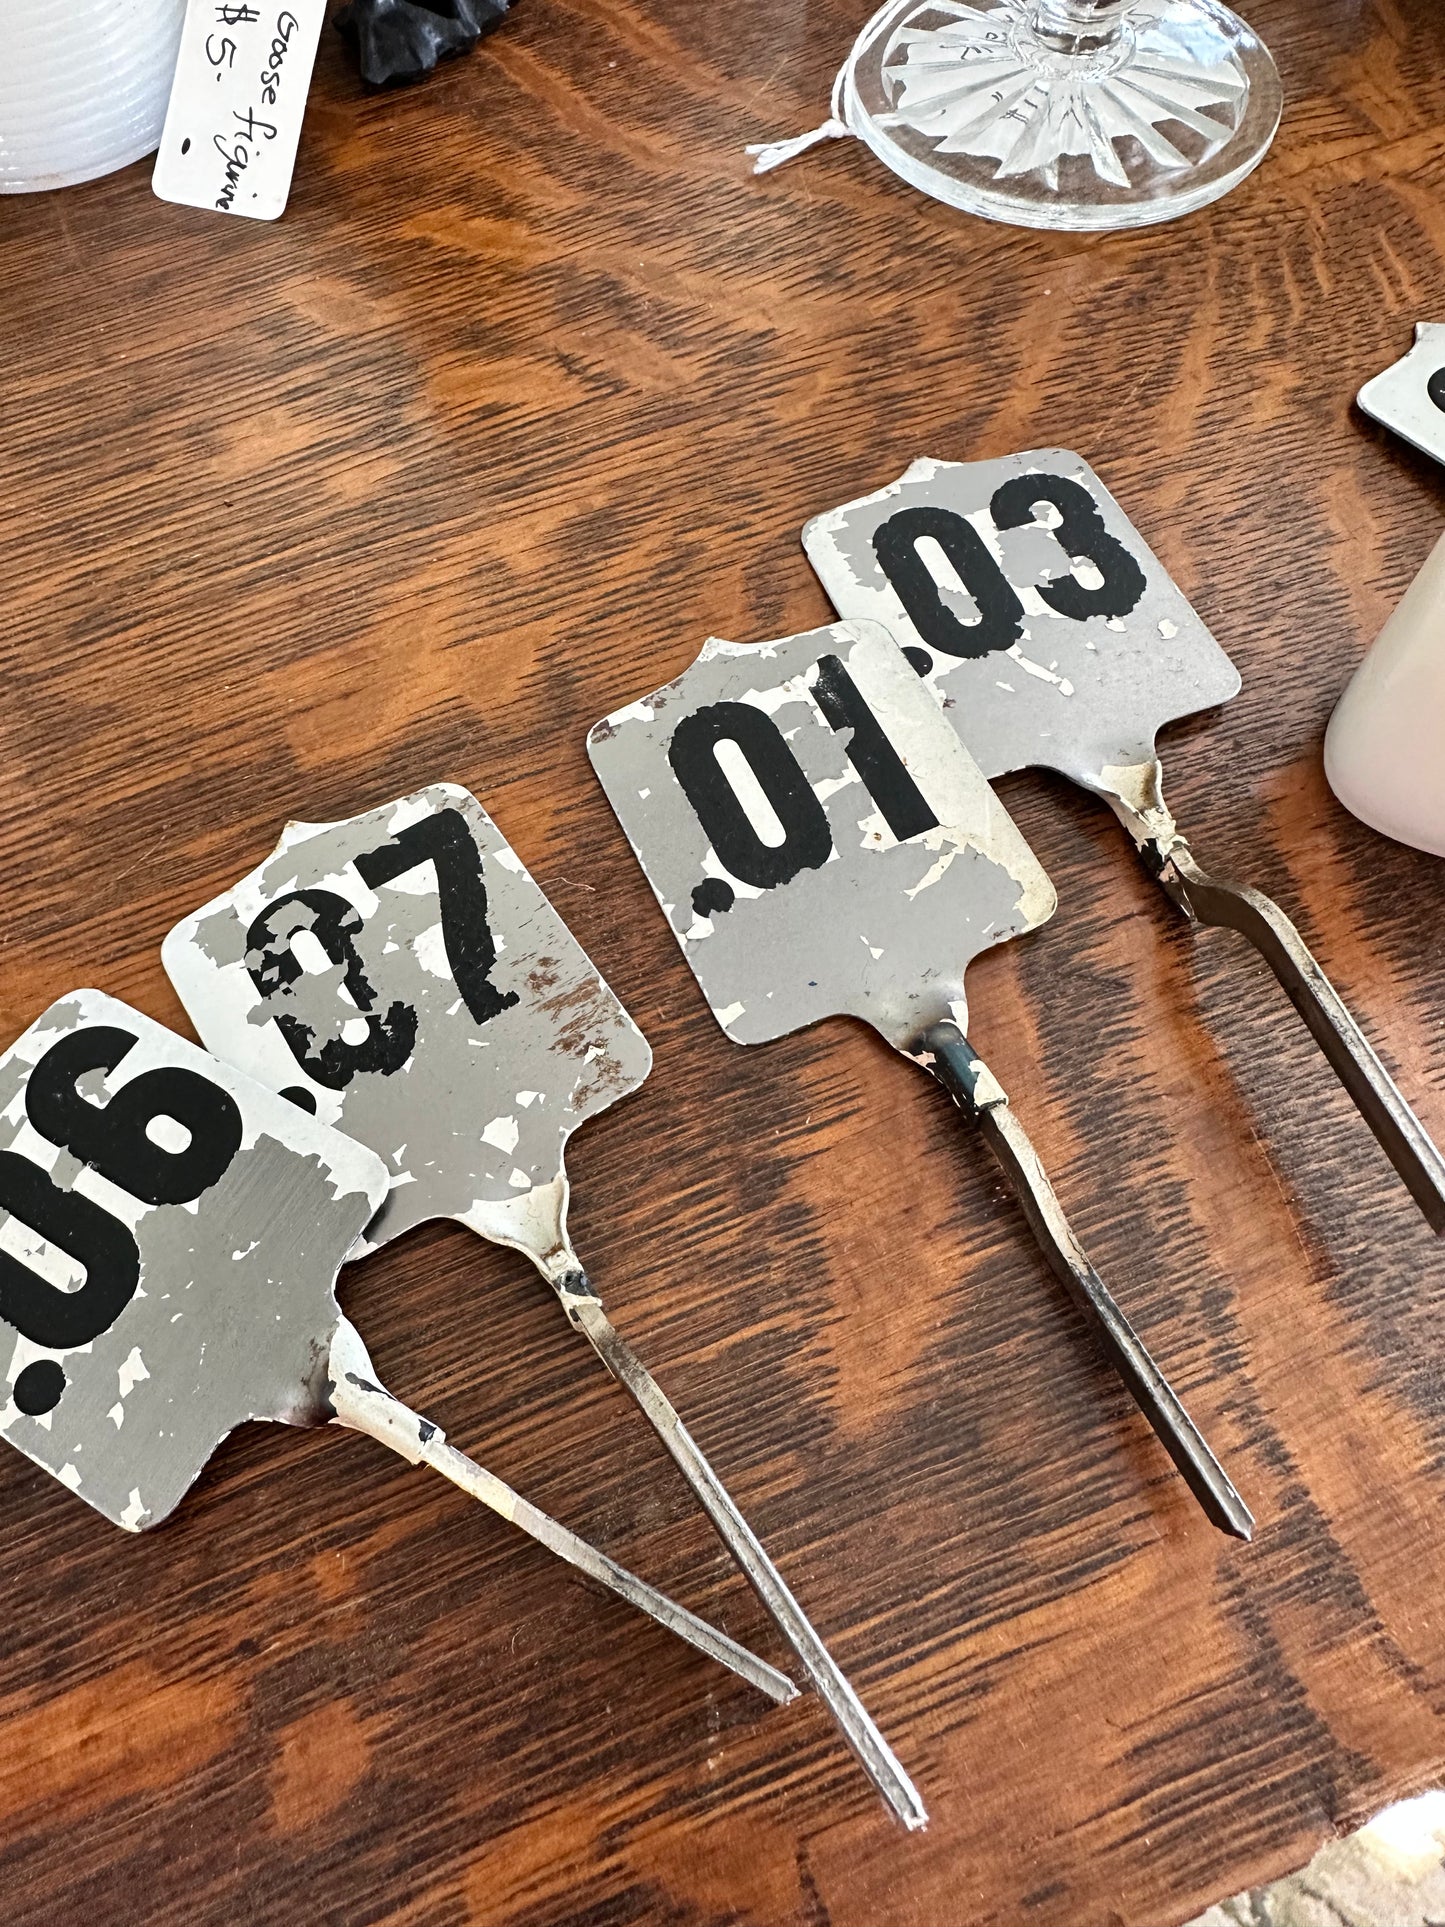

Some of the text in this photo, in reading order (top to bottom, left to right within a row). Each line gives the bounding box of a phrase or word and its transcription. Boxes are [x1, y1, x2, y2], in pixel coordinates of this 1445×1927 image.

[260, 11, 299, 105] Goose
[667, 653, 940, 918] .01
[0, 1025, 243, 1417] .06
